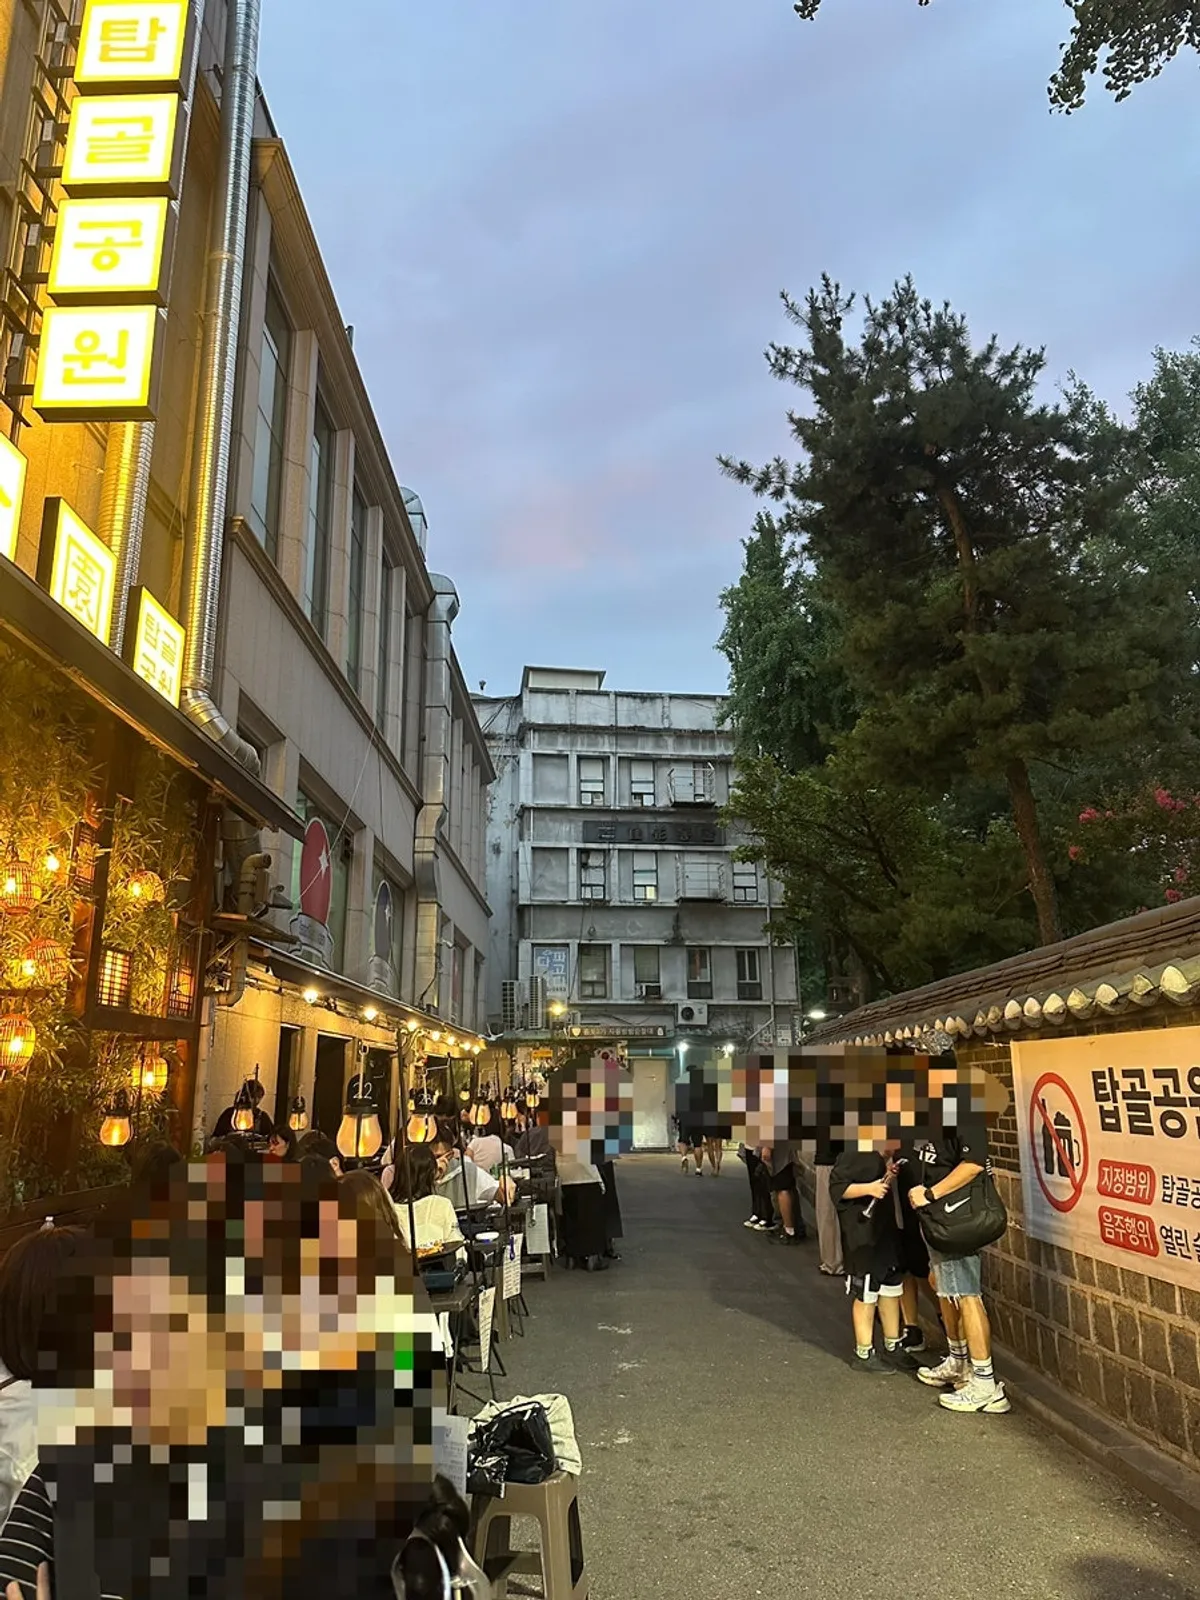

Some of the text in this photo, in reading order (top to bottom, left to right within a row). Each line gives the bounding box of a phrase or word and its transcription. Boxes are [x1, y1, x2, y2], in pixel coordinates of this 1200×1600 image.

[62, 17, 166, 384] 탑골공원
[144, 612, 177, 667] 탑골
[1101, 1165, 1151, 1199] 지정범위
[1102, 1211, 1154, 1250] 음주행위
[1160, 1225, 1192, 1260] 열린
